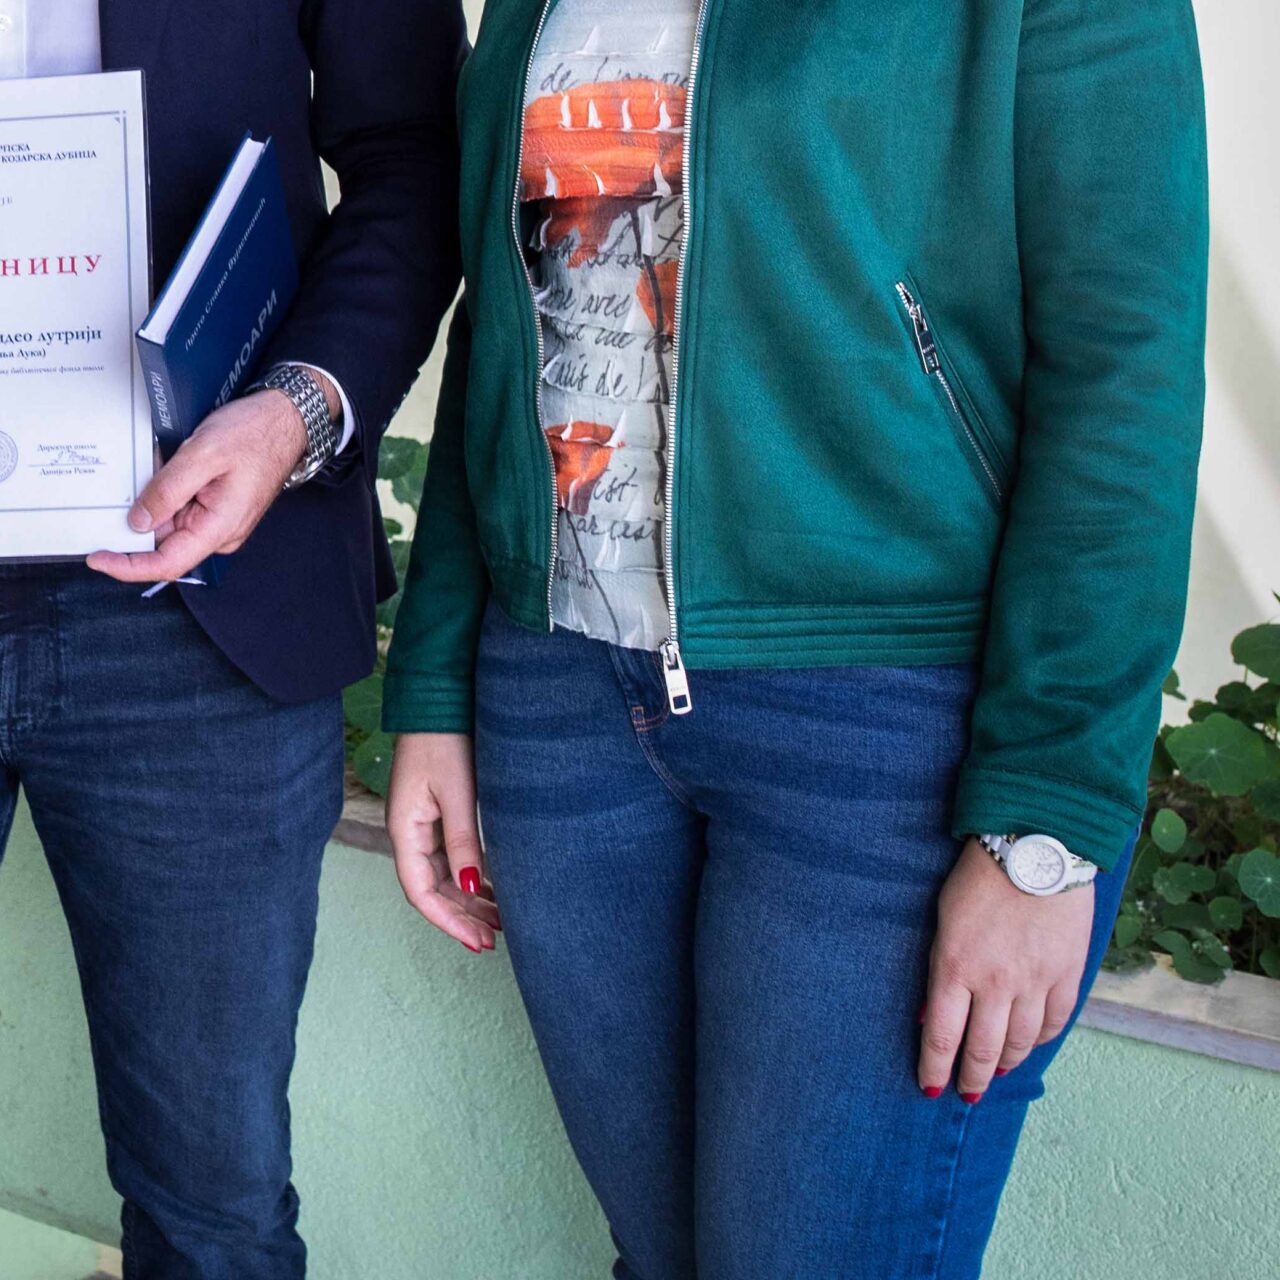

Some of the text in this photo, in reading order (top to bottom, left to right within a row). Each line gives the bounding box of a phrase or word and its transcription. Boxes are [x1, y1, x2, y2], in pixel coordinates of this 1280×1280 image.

[1, 152, 52, 164] КОЗАРСКА
[54, 149, 97, 161] ДУБИЦА
[38, 325, 102, 346] лутрији
